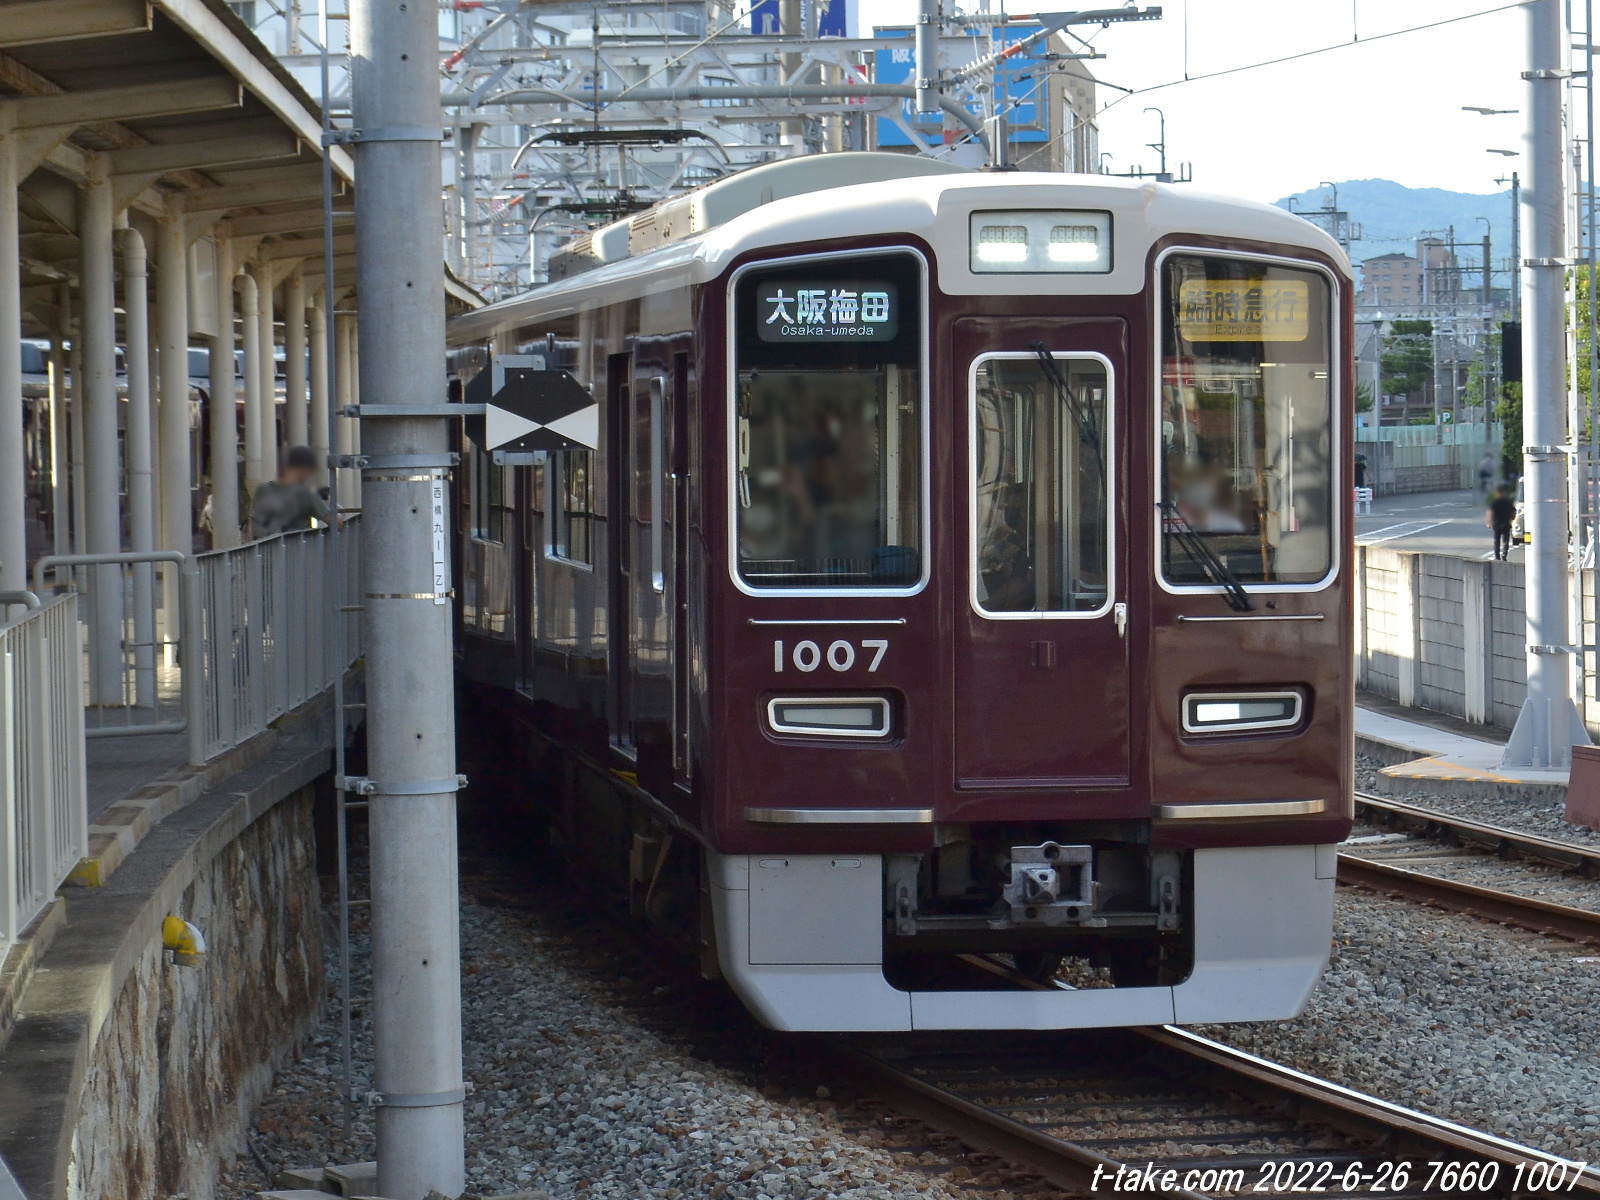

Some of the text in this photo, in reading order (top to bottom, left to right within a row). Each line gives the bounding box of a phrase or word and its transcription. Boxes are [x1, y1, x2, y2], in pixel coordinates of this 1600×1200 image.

[765, 288, 889, 324] 大阪梅田
[1185, 288, 1299, 324] 臨時急行
[781, 325, 874, 336] Osaka-umeda
[1214, 324, 1270, 337] Express
[1442, 411, 1451, 423] P
[774, 640, 889, 672] 1007
